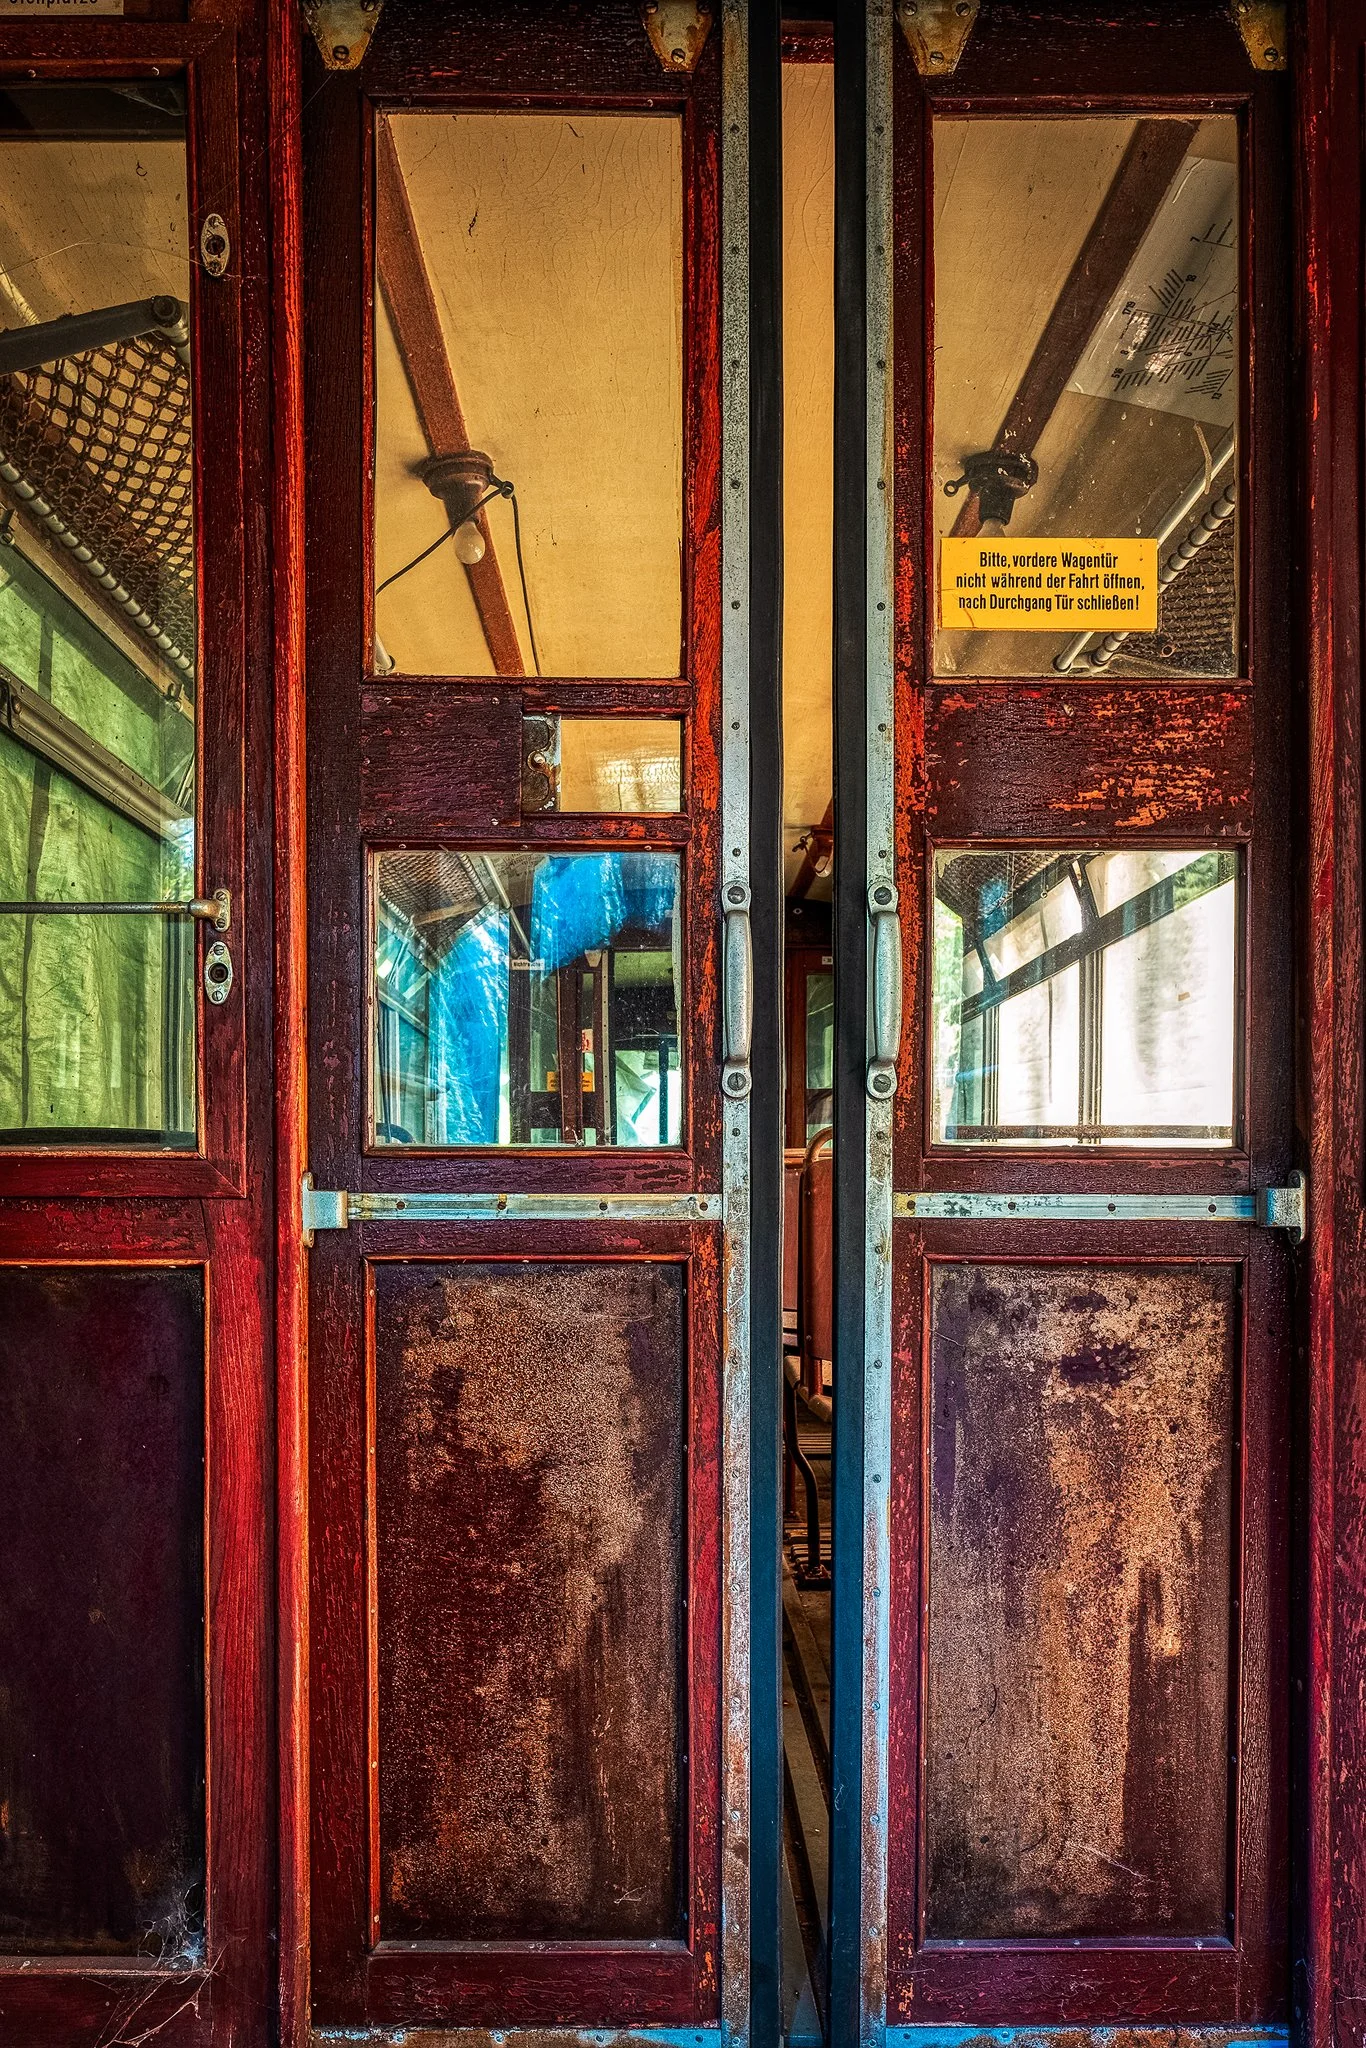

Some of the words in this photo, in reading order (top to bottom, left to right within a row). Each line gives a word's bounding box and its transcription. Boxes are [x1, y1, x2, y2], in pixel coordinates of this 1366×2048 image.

[979, 551, 1011, 570] Bitte,
[1012, 551, 1057, 568] vordere
[1061, 552, 1118, 570] Wagentür
[956, 572, 987, 588] nicht
[990, 572, 1041, 588] während
[1046, 573, 1066, 588] der
[1068, 573, 1100, 588] Fahrt
[1103, 573, 1145, 591] öffnen,
[958, 593, 987, 609] nach
[989, 594, 1052, 612] Durchgang
[1054, 594, 1075, 610] Tür
[1077, 594, 1139, 611] schließen!
